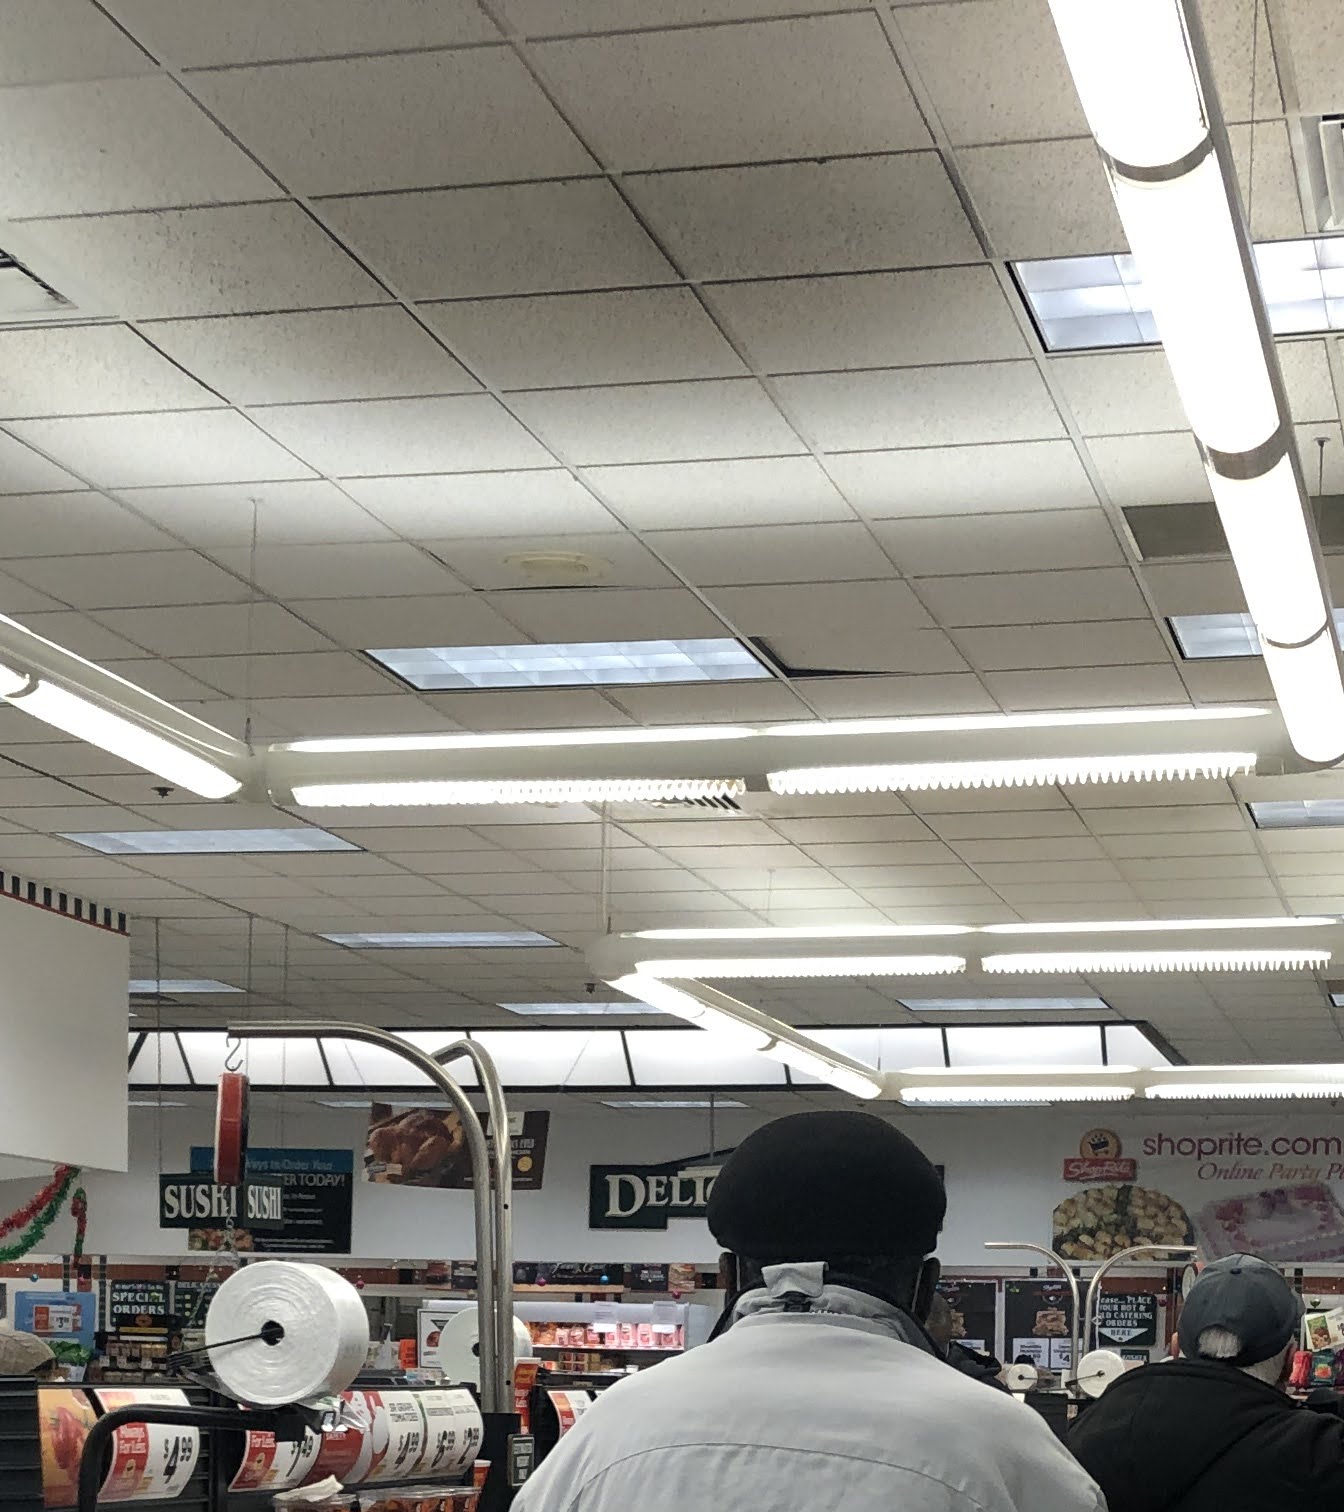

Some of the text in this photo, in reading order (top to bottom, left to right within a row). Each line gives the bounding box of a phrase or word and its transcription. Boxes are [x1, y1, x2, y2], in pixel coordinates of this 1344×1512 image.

[299, 1173, 345, 1187] TODAY!
[1197, 1161, 1264, 1181] Online
[1268, 1162, 1322, 1183] Party
[164, 1184, 238, 1219] SUSHI
[247, 1184, 282, 1220] SUSHI
[112, 1304, 165, 1315] ORDERS
